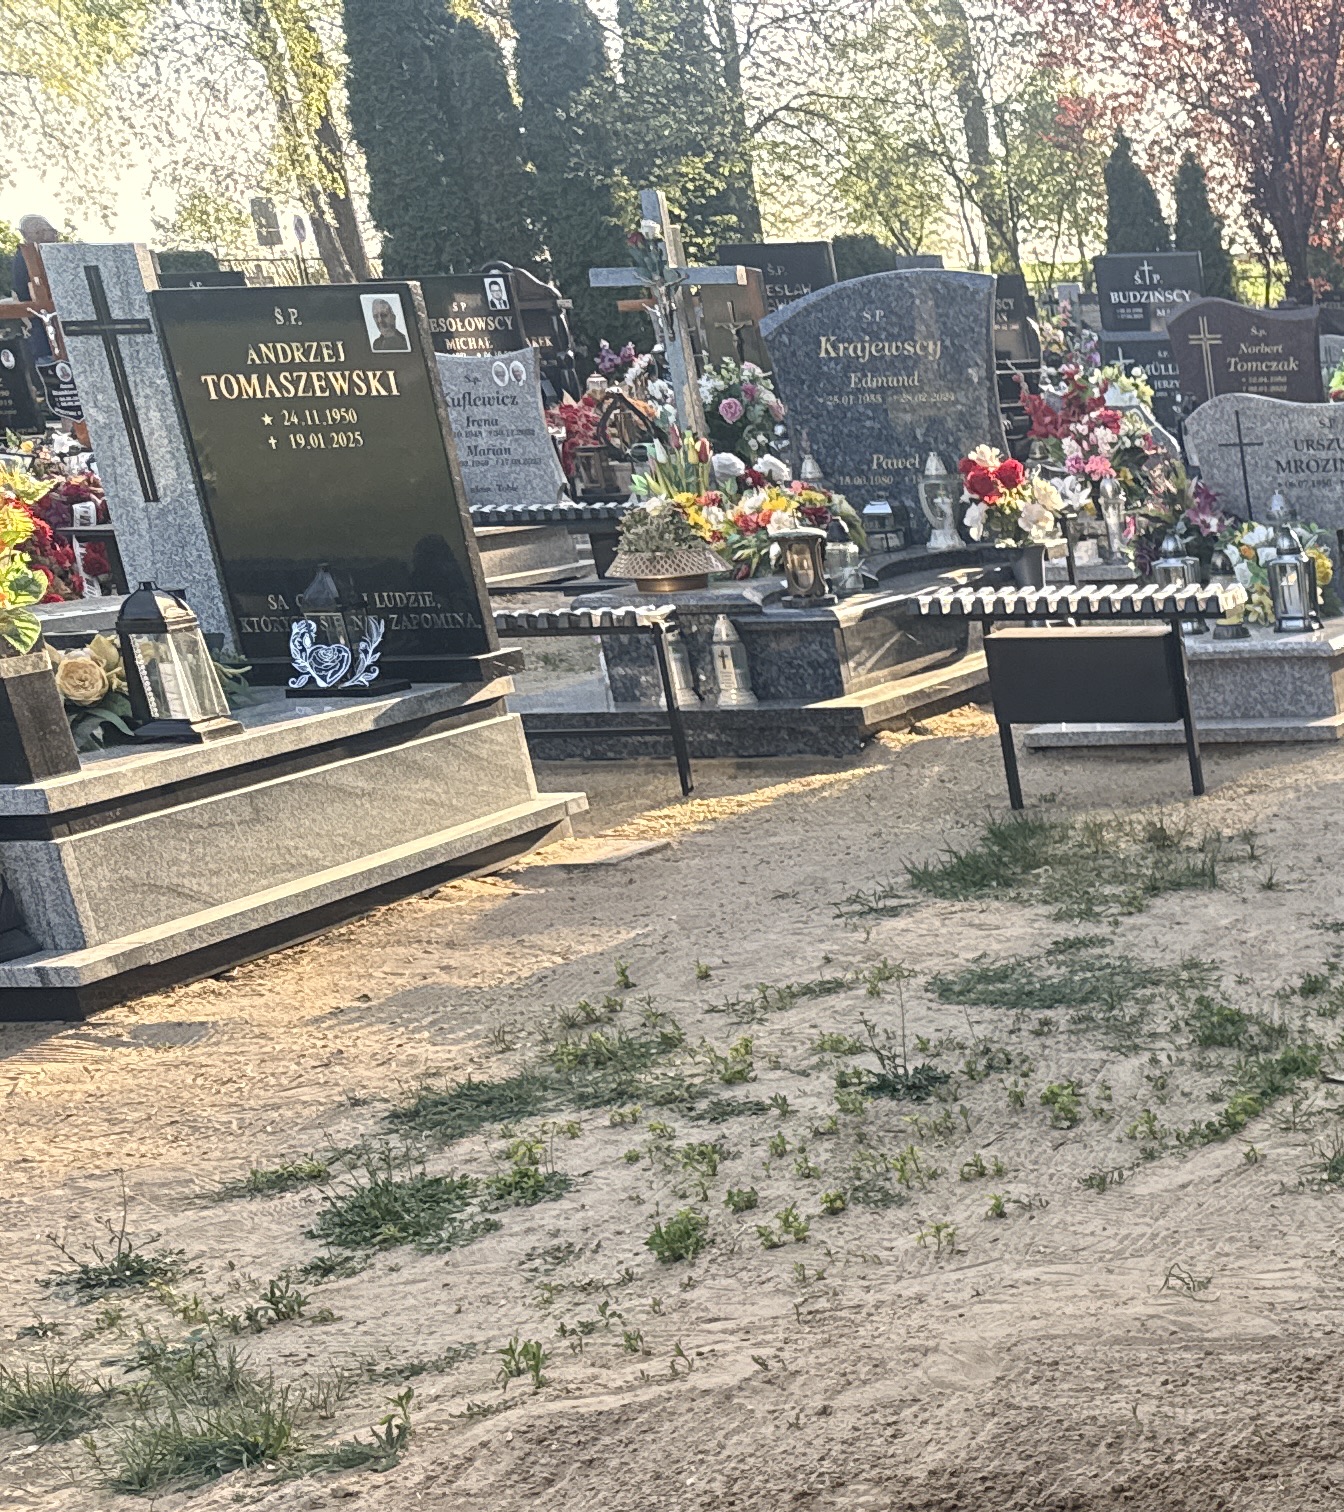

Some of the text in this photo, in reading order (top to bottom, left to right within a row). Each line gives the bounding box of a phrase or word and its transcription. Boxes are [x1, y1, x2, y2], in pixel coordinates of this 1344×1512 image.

[1110, 287, 1191, 303] BUDZIŃSCY
[430, 315, 513, 332] ESOŁOWSCY
[247, 341, 345, 364] ANDRZEJ
[819, 335, 941, 362] Krajewscy
[1239, 342, 1283, 354] Norbert
[1226, 356, 1299, 372] Tomczak
[201, 370, 400, 400] TOMASZEWSKI
[849, 371, 920, 388] Edmund
[281, 408, 358, 426] 24.11.1950
[467, 444, 511, 457] Marian
[239, 614, 303, 633] KTÓRY
